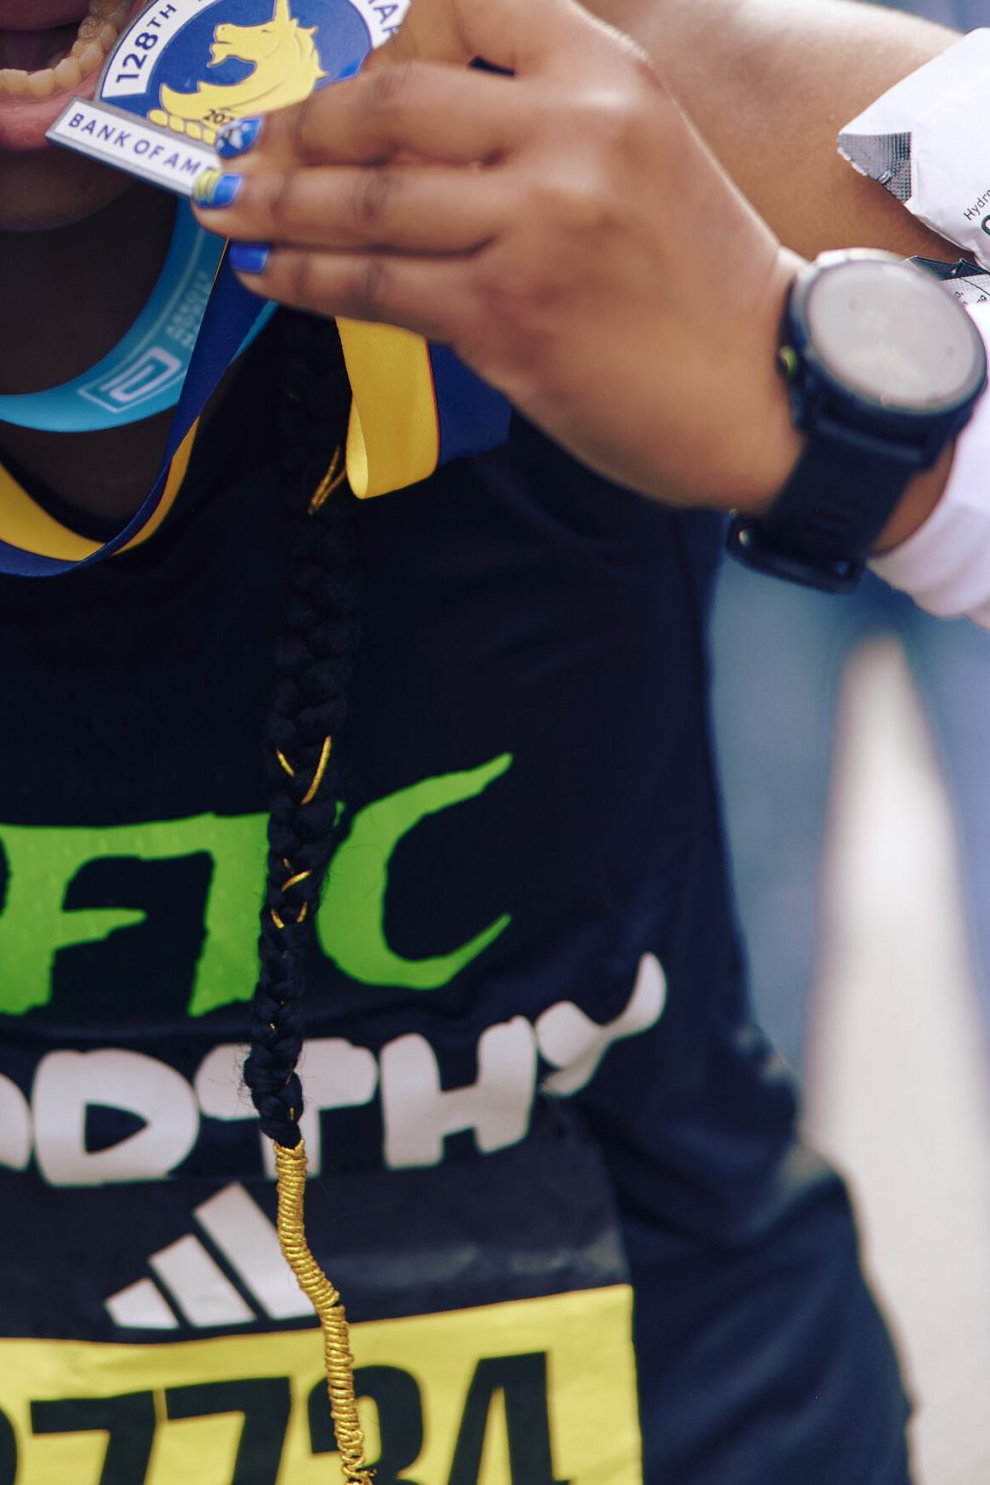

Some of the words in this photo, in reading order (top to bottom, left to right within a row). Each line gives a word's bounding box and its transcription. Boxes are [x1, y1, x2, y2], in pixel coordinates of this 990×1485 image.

[115, 3, 177, 83] 128TH
[67, 112, 132, 149] BANK
[132, 138, 166, 161] OF
[164, 152, 214, 176] AM
